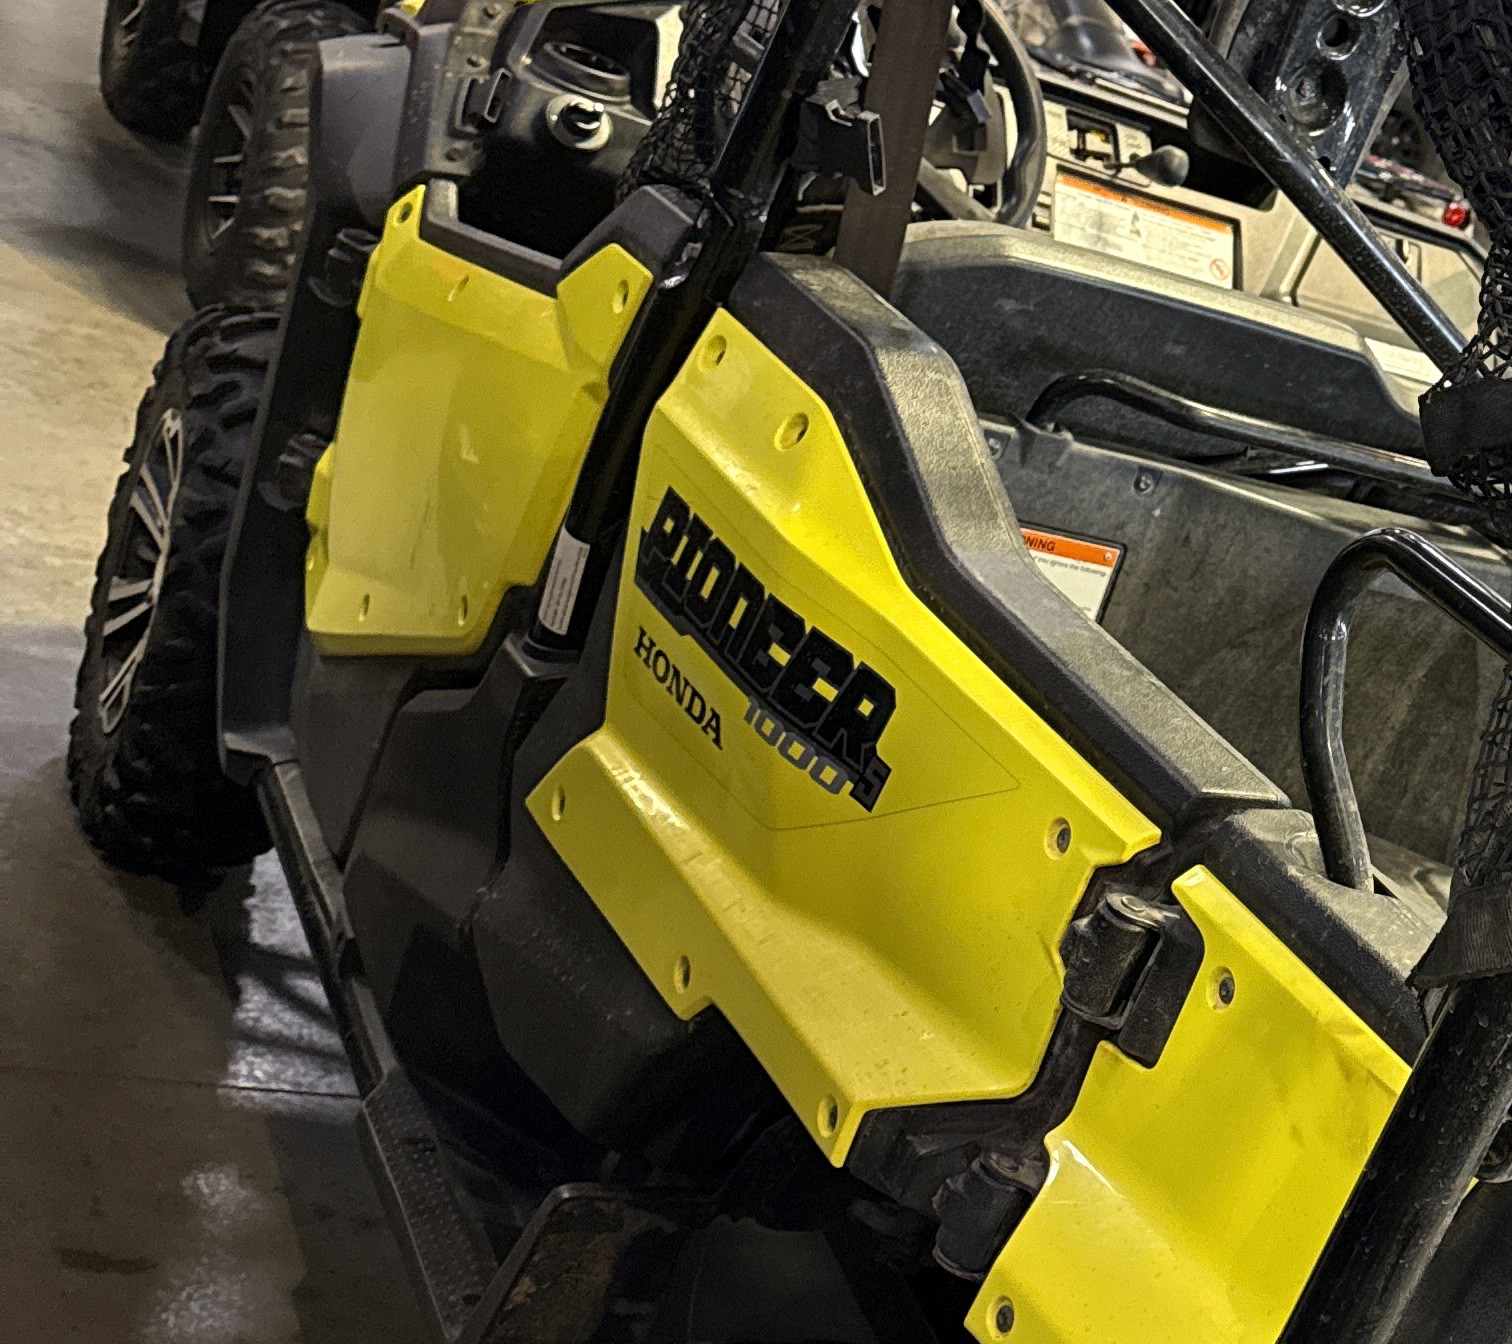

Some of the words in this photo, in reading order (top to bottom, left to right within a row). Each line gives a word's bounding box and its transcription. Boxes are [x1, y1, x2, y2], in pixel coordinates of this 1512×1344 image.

[1025, 536, 1056, 552] NING
[633, 626, 723, 751] HONDA
[635, 485, 898, 775] PIONEER
